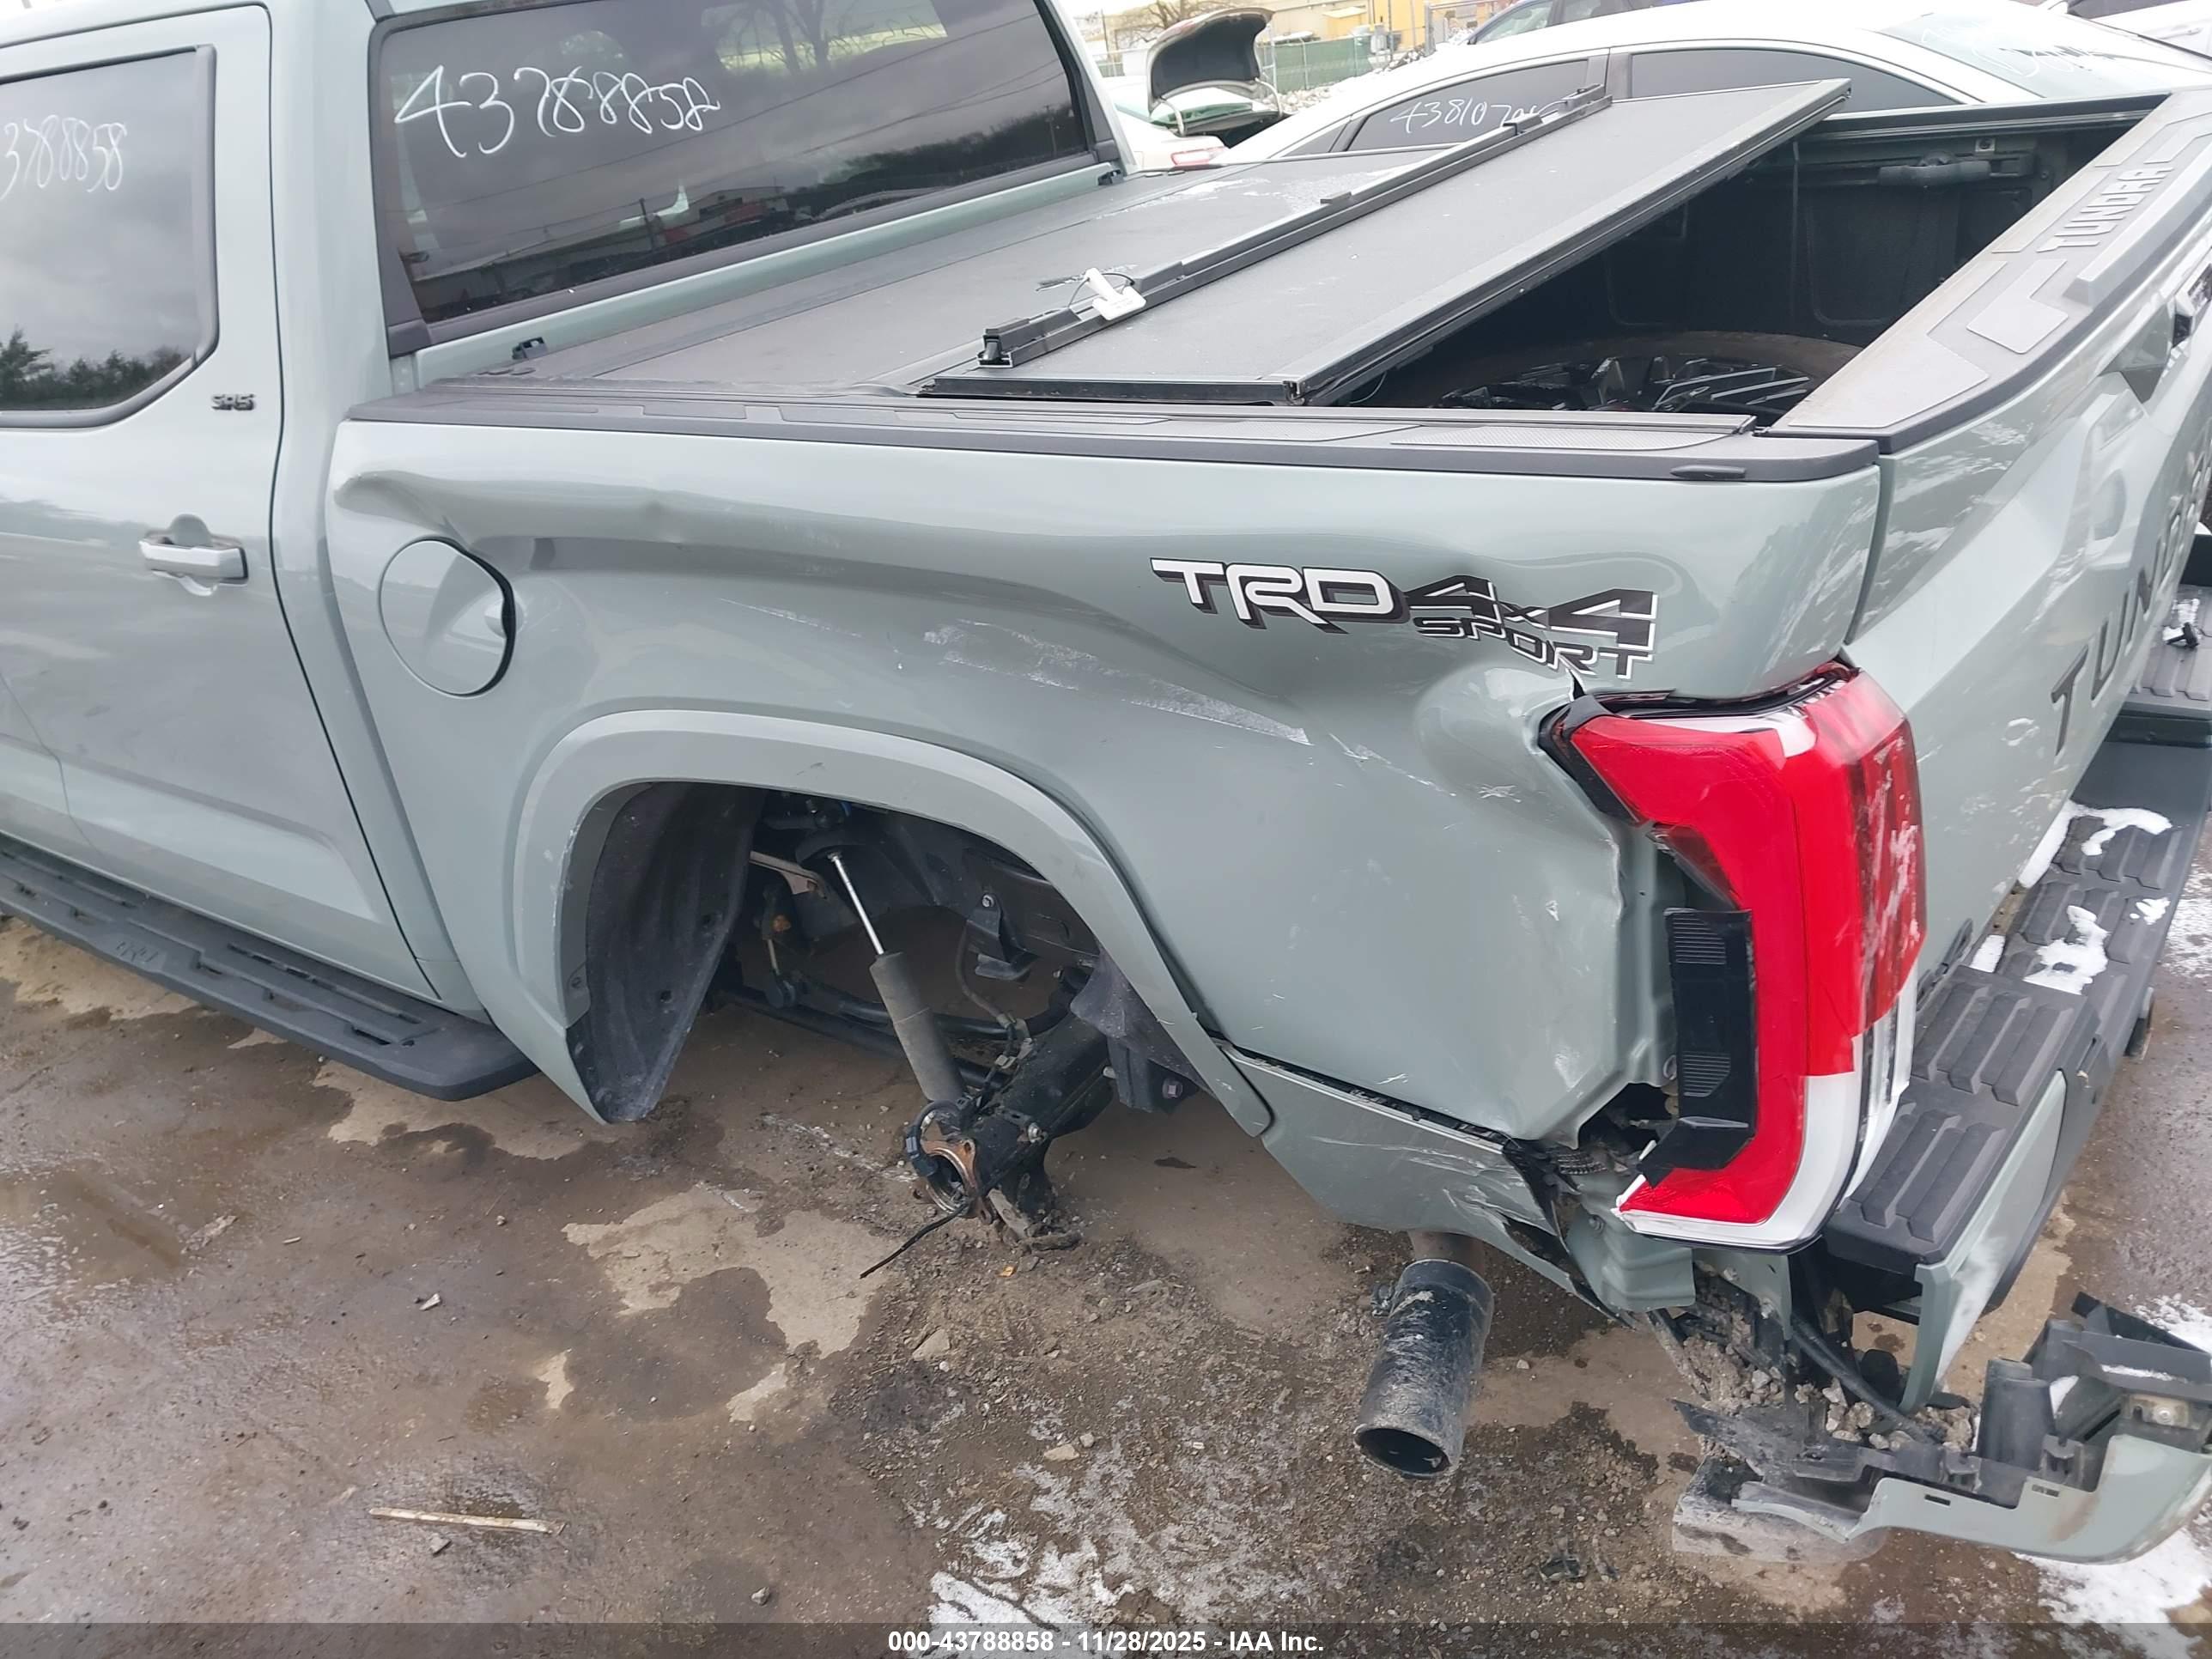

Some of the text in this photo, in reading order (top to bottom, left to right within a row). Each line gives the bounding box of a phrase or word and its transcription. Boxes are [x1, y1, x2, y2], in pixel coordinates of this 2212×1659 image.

[2036, 167, 2174, 252] TUNDRA
[211, 393, 255, 411] SR5
[1150, 557, 1410, 635] TRD
[1413, 616, 1654, 679] SPORT
